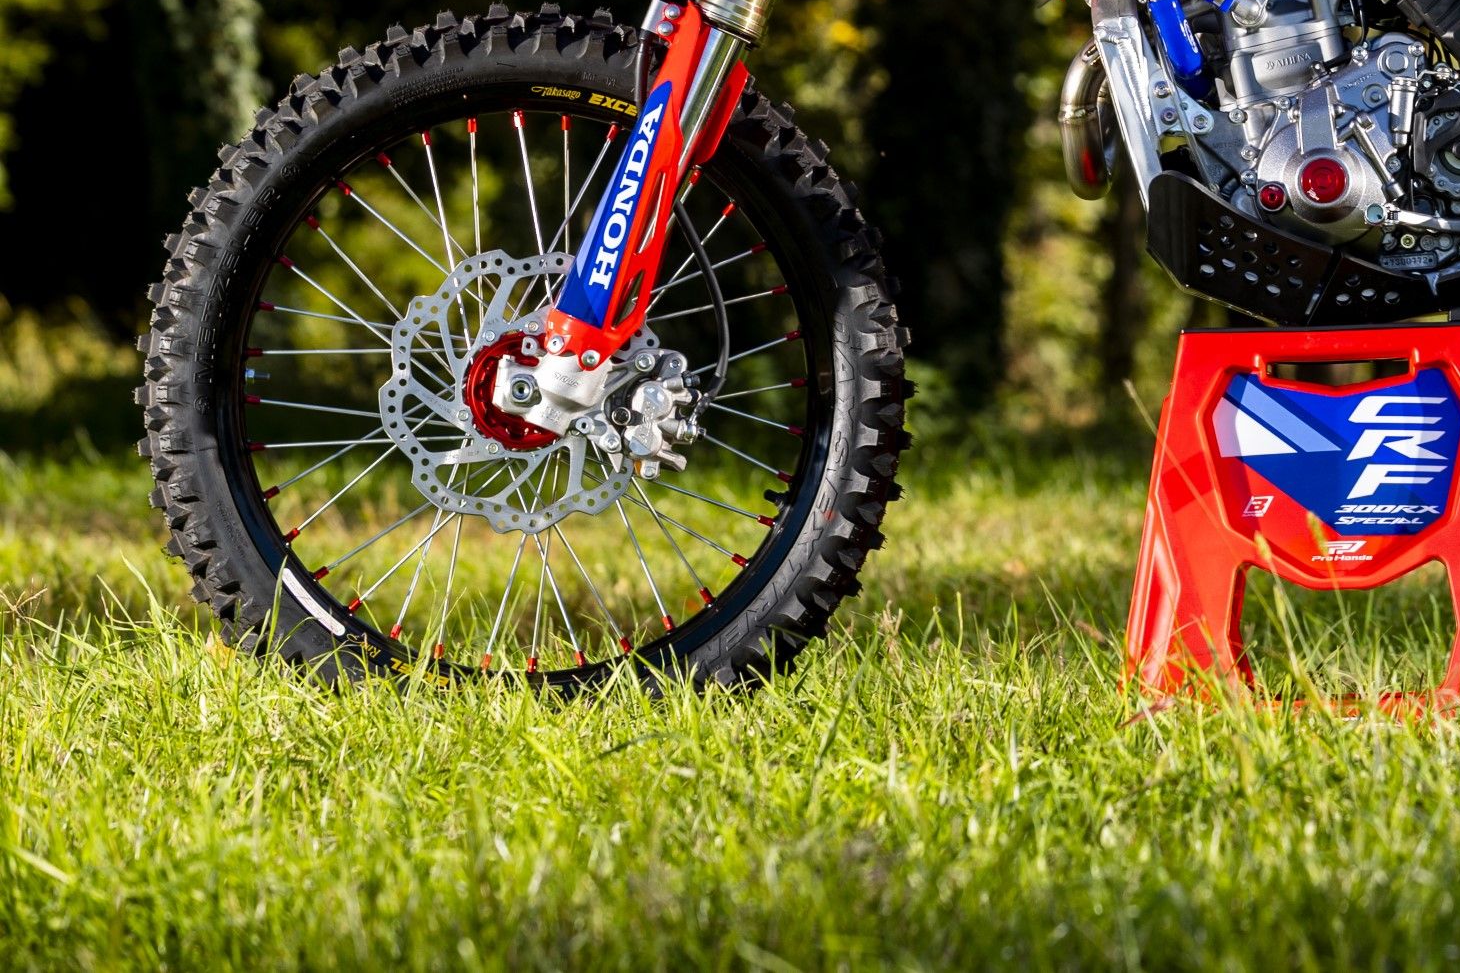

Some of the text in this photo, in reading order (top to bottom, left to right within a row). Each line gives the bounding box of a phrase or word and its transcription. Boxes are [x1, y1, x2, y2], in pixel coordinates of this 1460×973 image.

[531, 86, 639, 117] Takasago EXCE
[588, 103, 664, 291] HONDA
[1346, 395, 1449, 500] CRF
[1334, 504, 1441, 515] 300RX
[1334, 516, 1424, 525] SPECIAL
